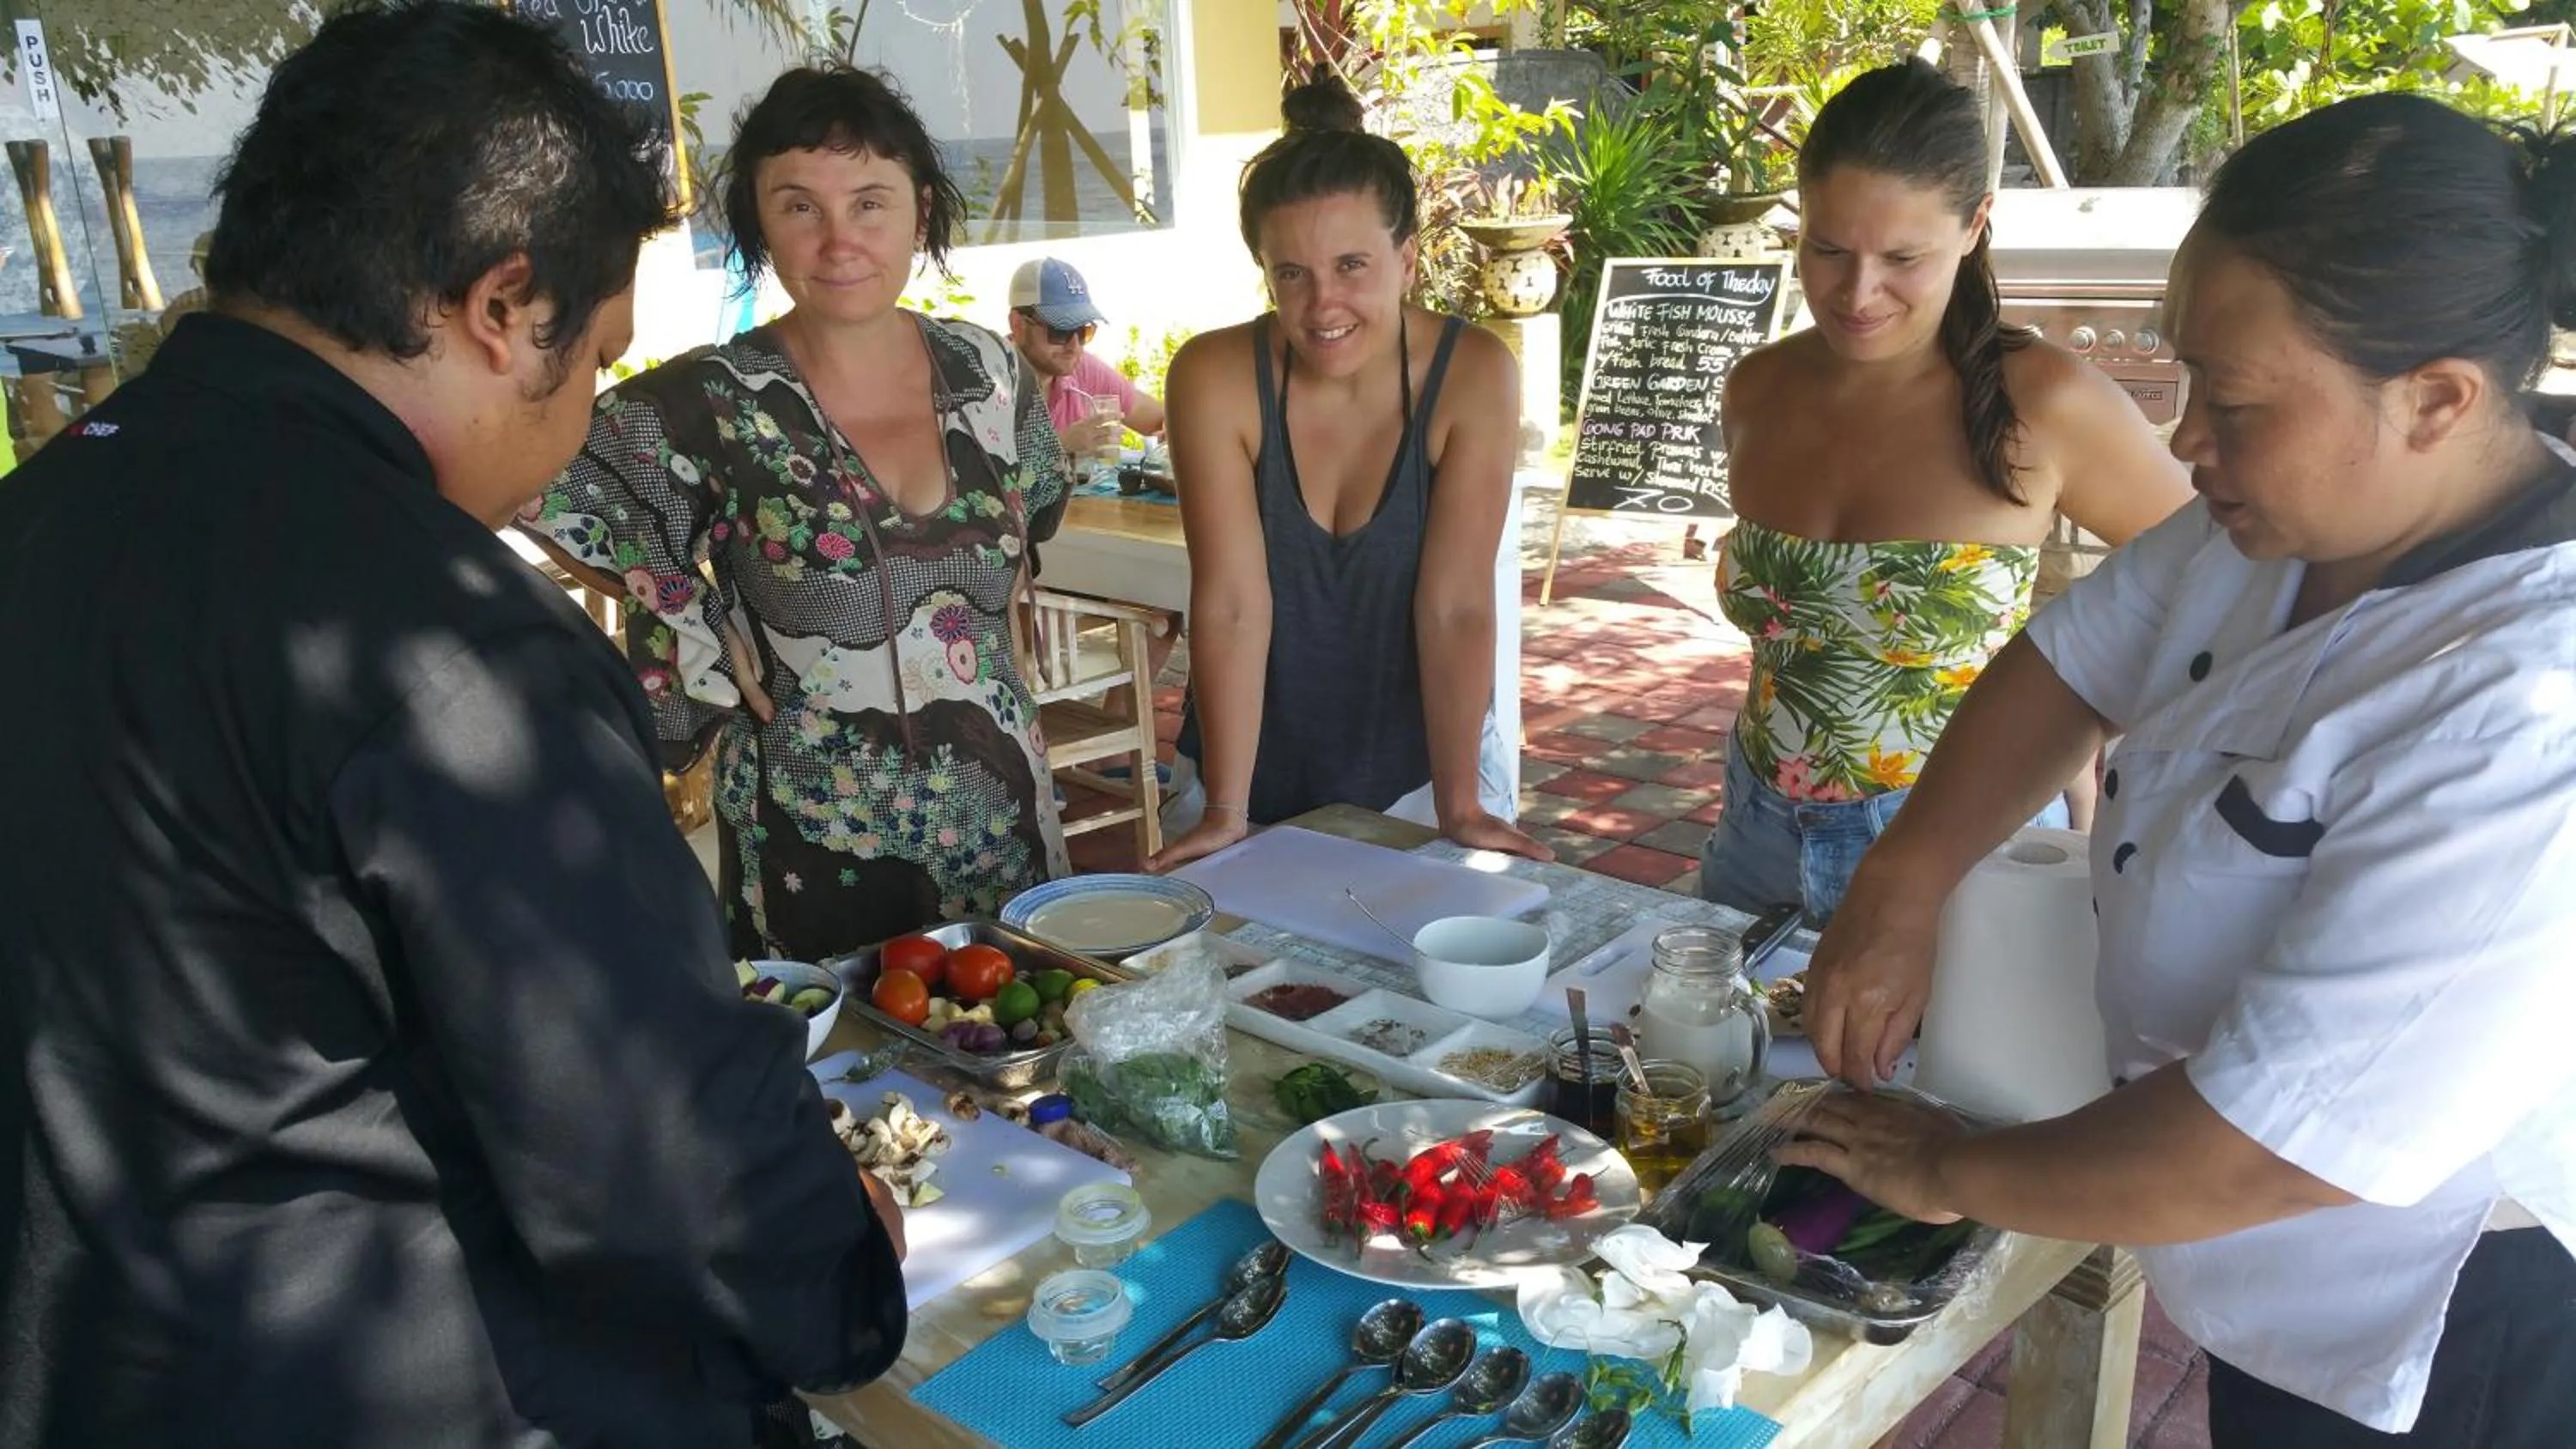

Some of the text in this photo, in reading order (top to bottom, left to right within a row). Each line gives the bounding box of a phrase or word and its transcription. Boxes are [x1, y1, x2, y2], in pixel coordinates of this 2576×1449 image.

[580, 5, 653, 54] White
[25, 35, 51, 102] PUSH
[1641, 268, 1692, 288] Food
[1656, 302, 1692, 322] FISH
[1695, 355, 1727, 373] 55
[1591, 368, 1642, 391] GREEN
[1647, 372, 1710, 392] GARDEN
[1582, 418, 1702, 444] GONG PAD PRIK
[1613, 485, 1694, 512] 70
